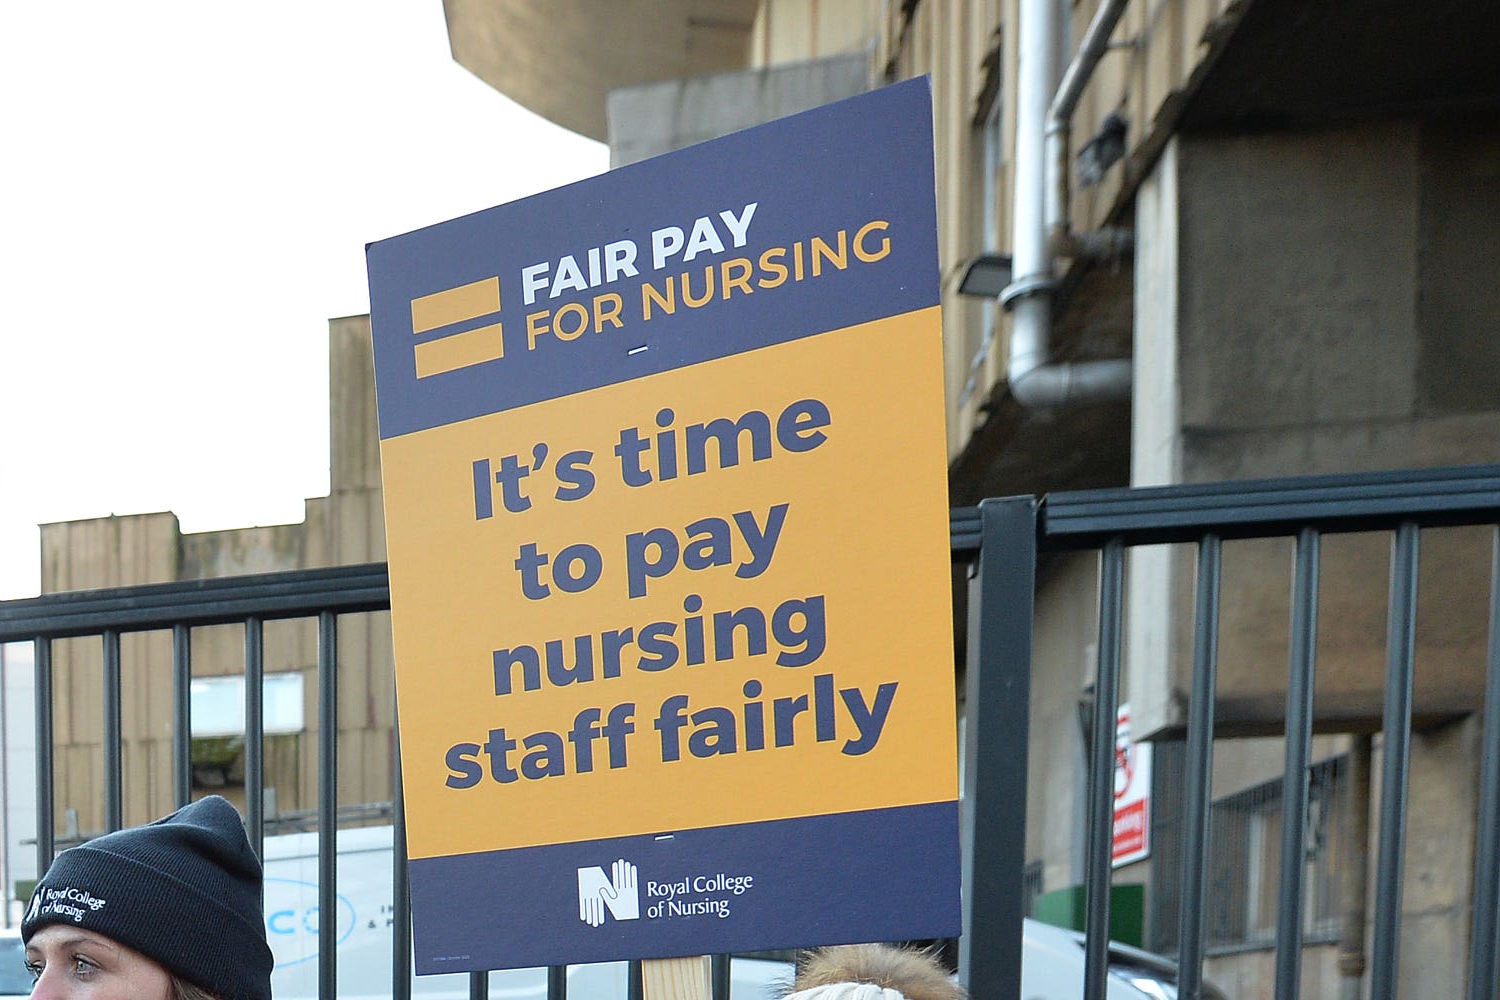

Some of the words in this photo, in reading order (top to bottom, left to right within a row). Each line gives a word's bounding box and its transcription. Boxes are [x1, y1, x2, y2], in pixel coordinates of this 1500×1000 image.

[521, 239, 640, 306] FAIR
[651, 202, 758, 270] PAY
[525, 291, 625, 351] FOR
[641, 219, 893, 321] NURSING
[472, 442, 596, 521] It’s
[614, 398, 831, 488] time
[515, 542, 603, 601] to
[626, 503, 790, 600] pay
[493, 594, 827, 697] nursing
[445, 702, 636, 790] staff
[653, 673, 899, 763] fairly
[46, 886, 69, 901] Royal
[68, 889, 106, 911] College
[51, 899, 86, 922] Nursing
[647, 876, 690, 902] Royal
[694, 873, 754, 895] College
[647, 900, 666, 919] of
[669, 897, 731, 918] Nursing
